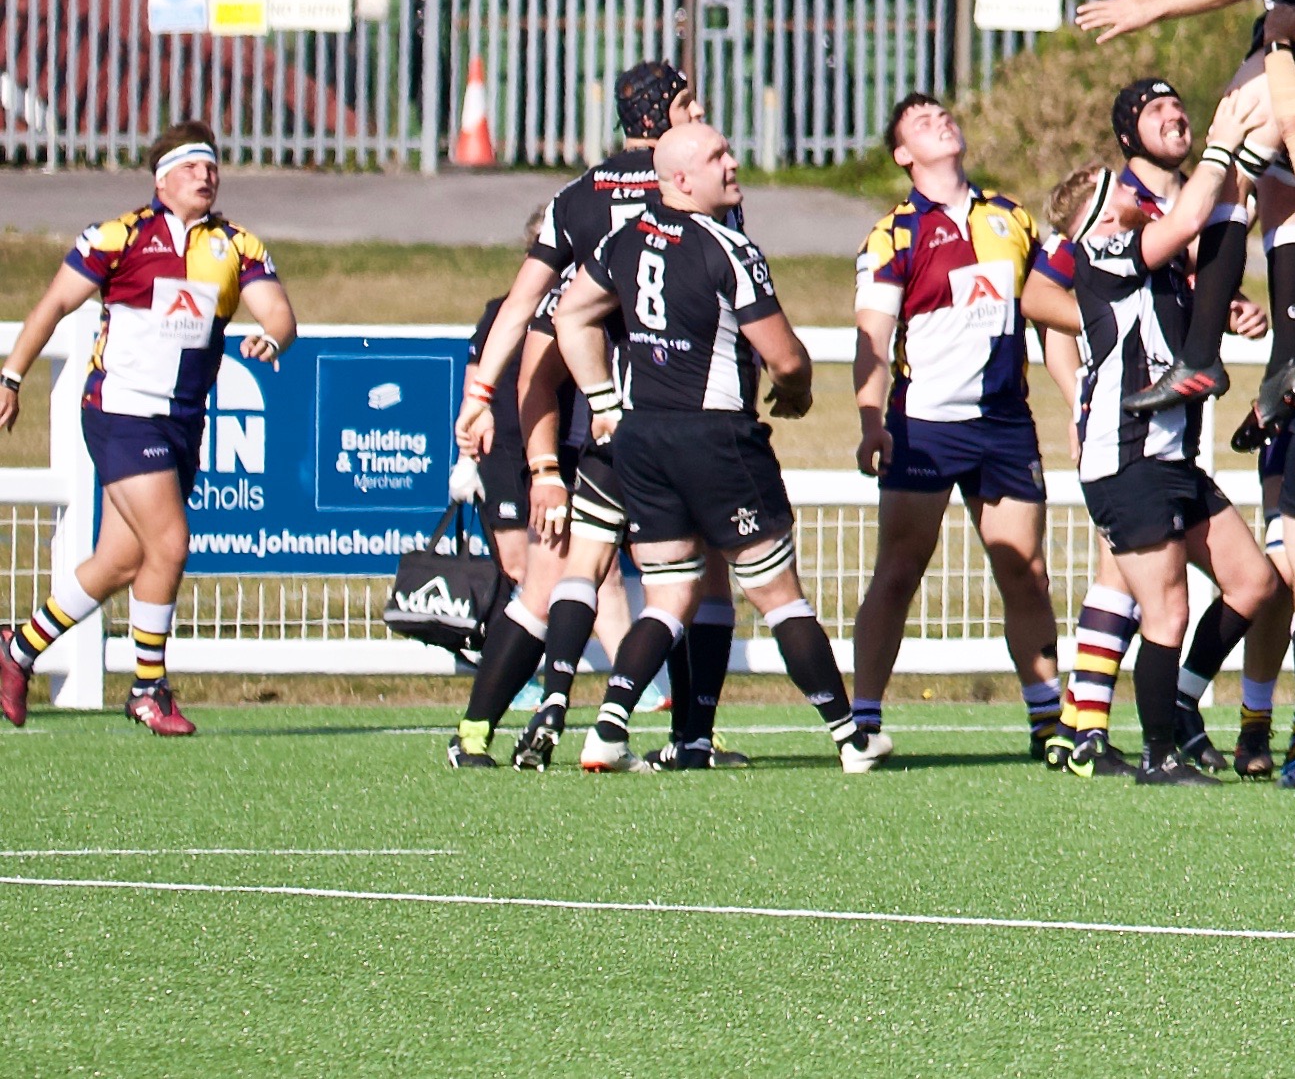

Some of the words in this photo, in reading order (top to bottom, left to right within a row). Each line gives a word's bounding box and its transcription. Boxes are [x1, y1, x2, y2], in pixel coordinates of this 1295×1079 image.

[593, 169, 659, 183] WILDMA
[635, 249, 668, 332] 8
[341, 428, 427, 455] Building
[335, 451, 353, 474] &
[357, 451, 432, 474] Timber
[353, 474, 413, 491] Merchant
[188, 478, 264, 511] cholls
[737, 517, 761, 536] 6X
